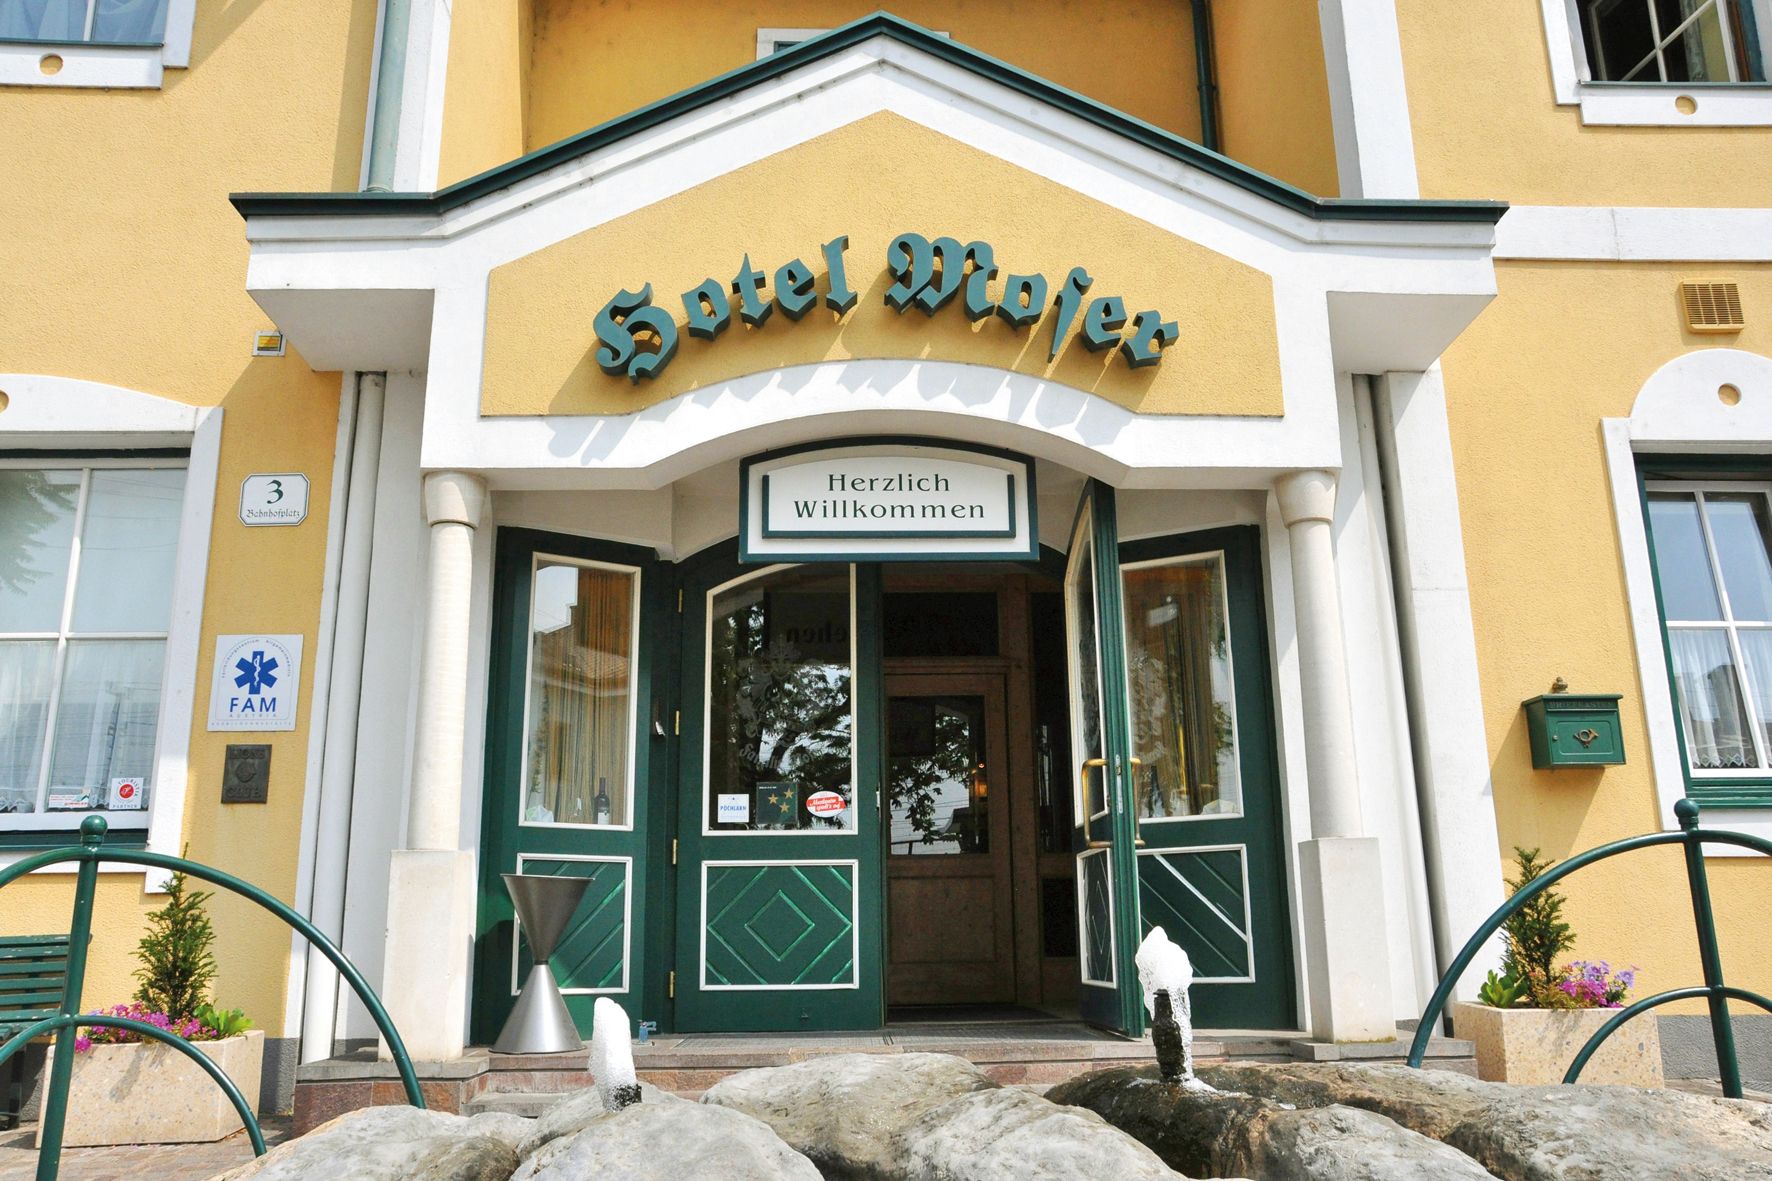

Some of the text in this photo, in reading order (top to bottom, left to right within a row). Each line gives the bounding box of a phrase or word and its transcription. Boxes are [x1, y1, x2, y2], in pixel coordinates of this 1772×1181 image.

[592, 235, 858, 385] Hotel
[266, 479, 284, 505] 3
[827, 472, 950, 492] Herzlich
[793, 498, 985, 519] Willkommen
[229, 697, 277, 713] FAM
